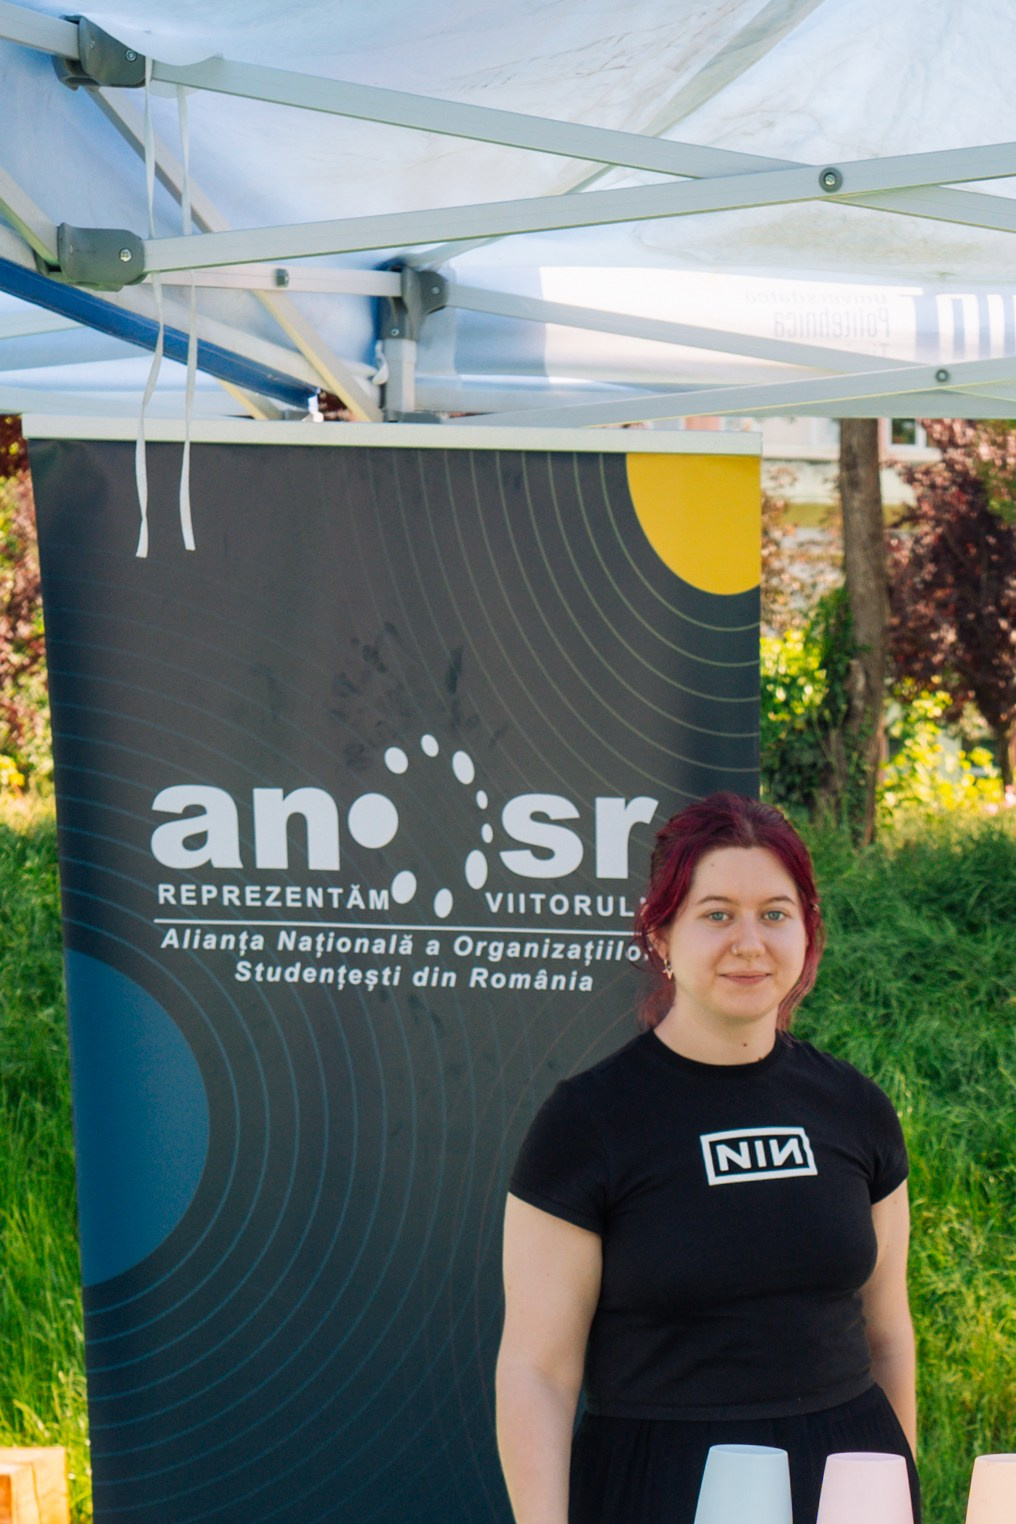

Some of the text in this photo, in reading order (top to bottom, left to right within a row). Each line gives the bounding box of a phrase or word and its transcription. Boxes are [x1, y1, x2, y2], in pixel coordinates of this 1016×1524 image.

[157, 883, 390, 911] REPREZENTĂM
[160, 927, 265, 957] Alianța
[277, 929, 415, 959] Națională
[425, 938, 441, 956] a
[234, 960, 594, 992] Studențești din România
